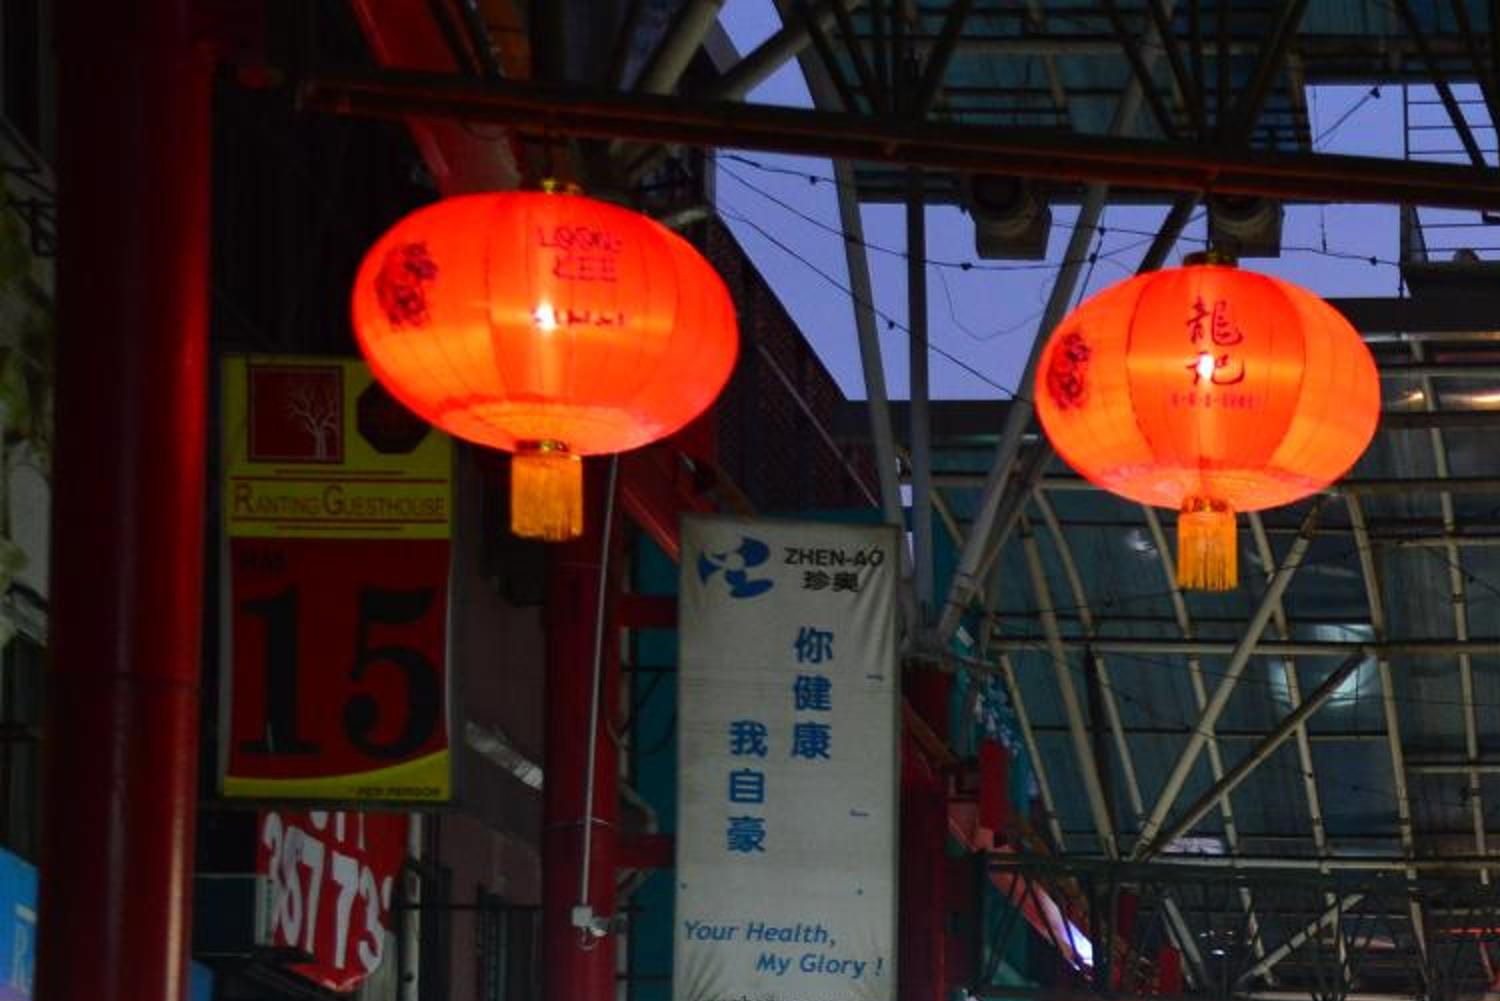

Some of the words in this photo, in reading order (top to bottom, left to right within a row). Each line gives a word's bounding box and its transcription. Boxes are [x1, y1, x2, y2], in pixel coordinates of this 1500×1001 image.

[783, 547, 886, 567] ZHEN-AO
[240, 584, 441, 761] 15
[790, 626, 834, 760] 你健康
[726, 720, 769, 853] 我自豪
[684, 919, 737, 942] Your
[744, 920, 838, 948] Health,
[756, 954, 791, 976] My
[799, 955, 867, 980] Glory
